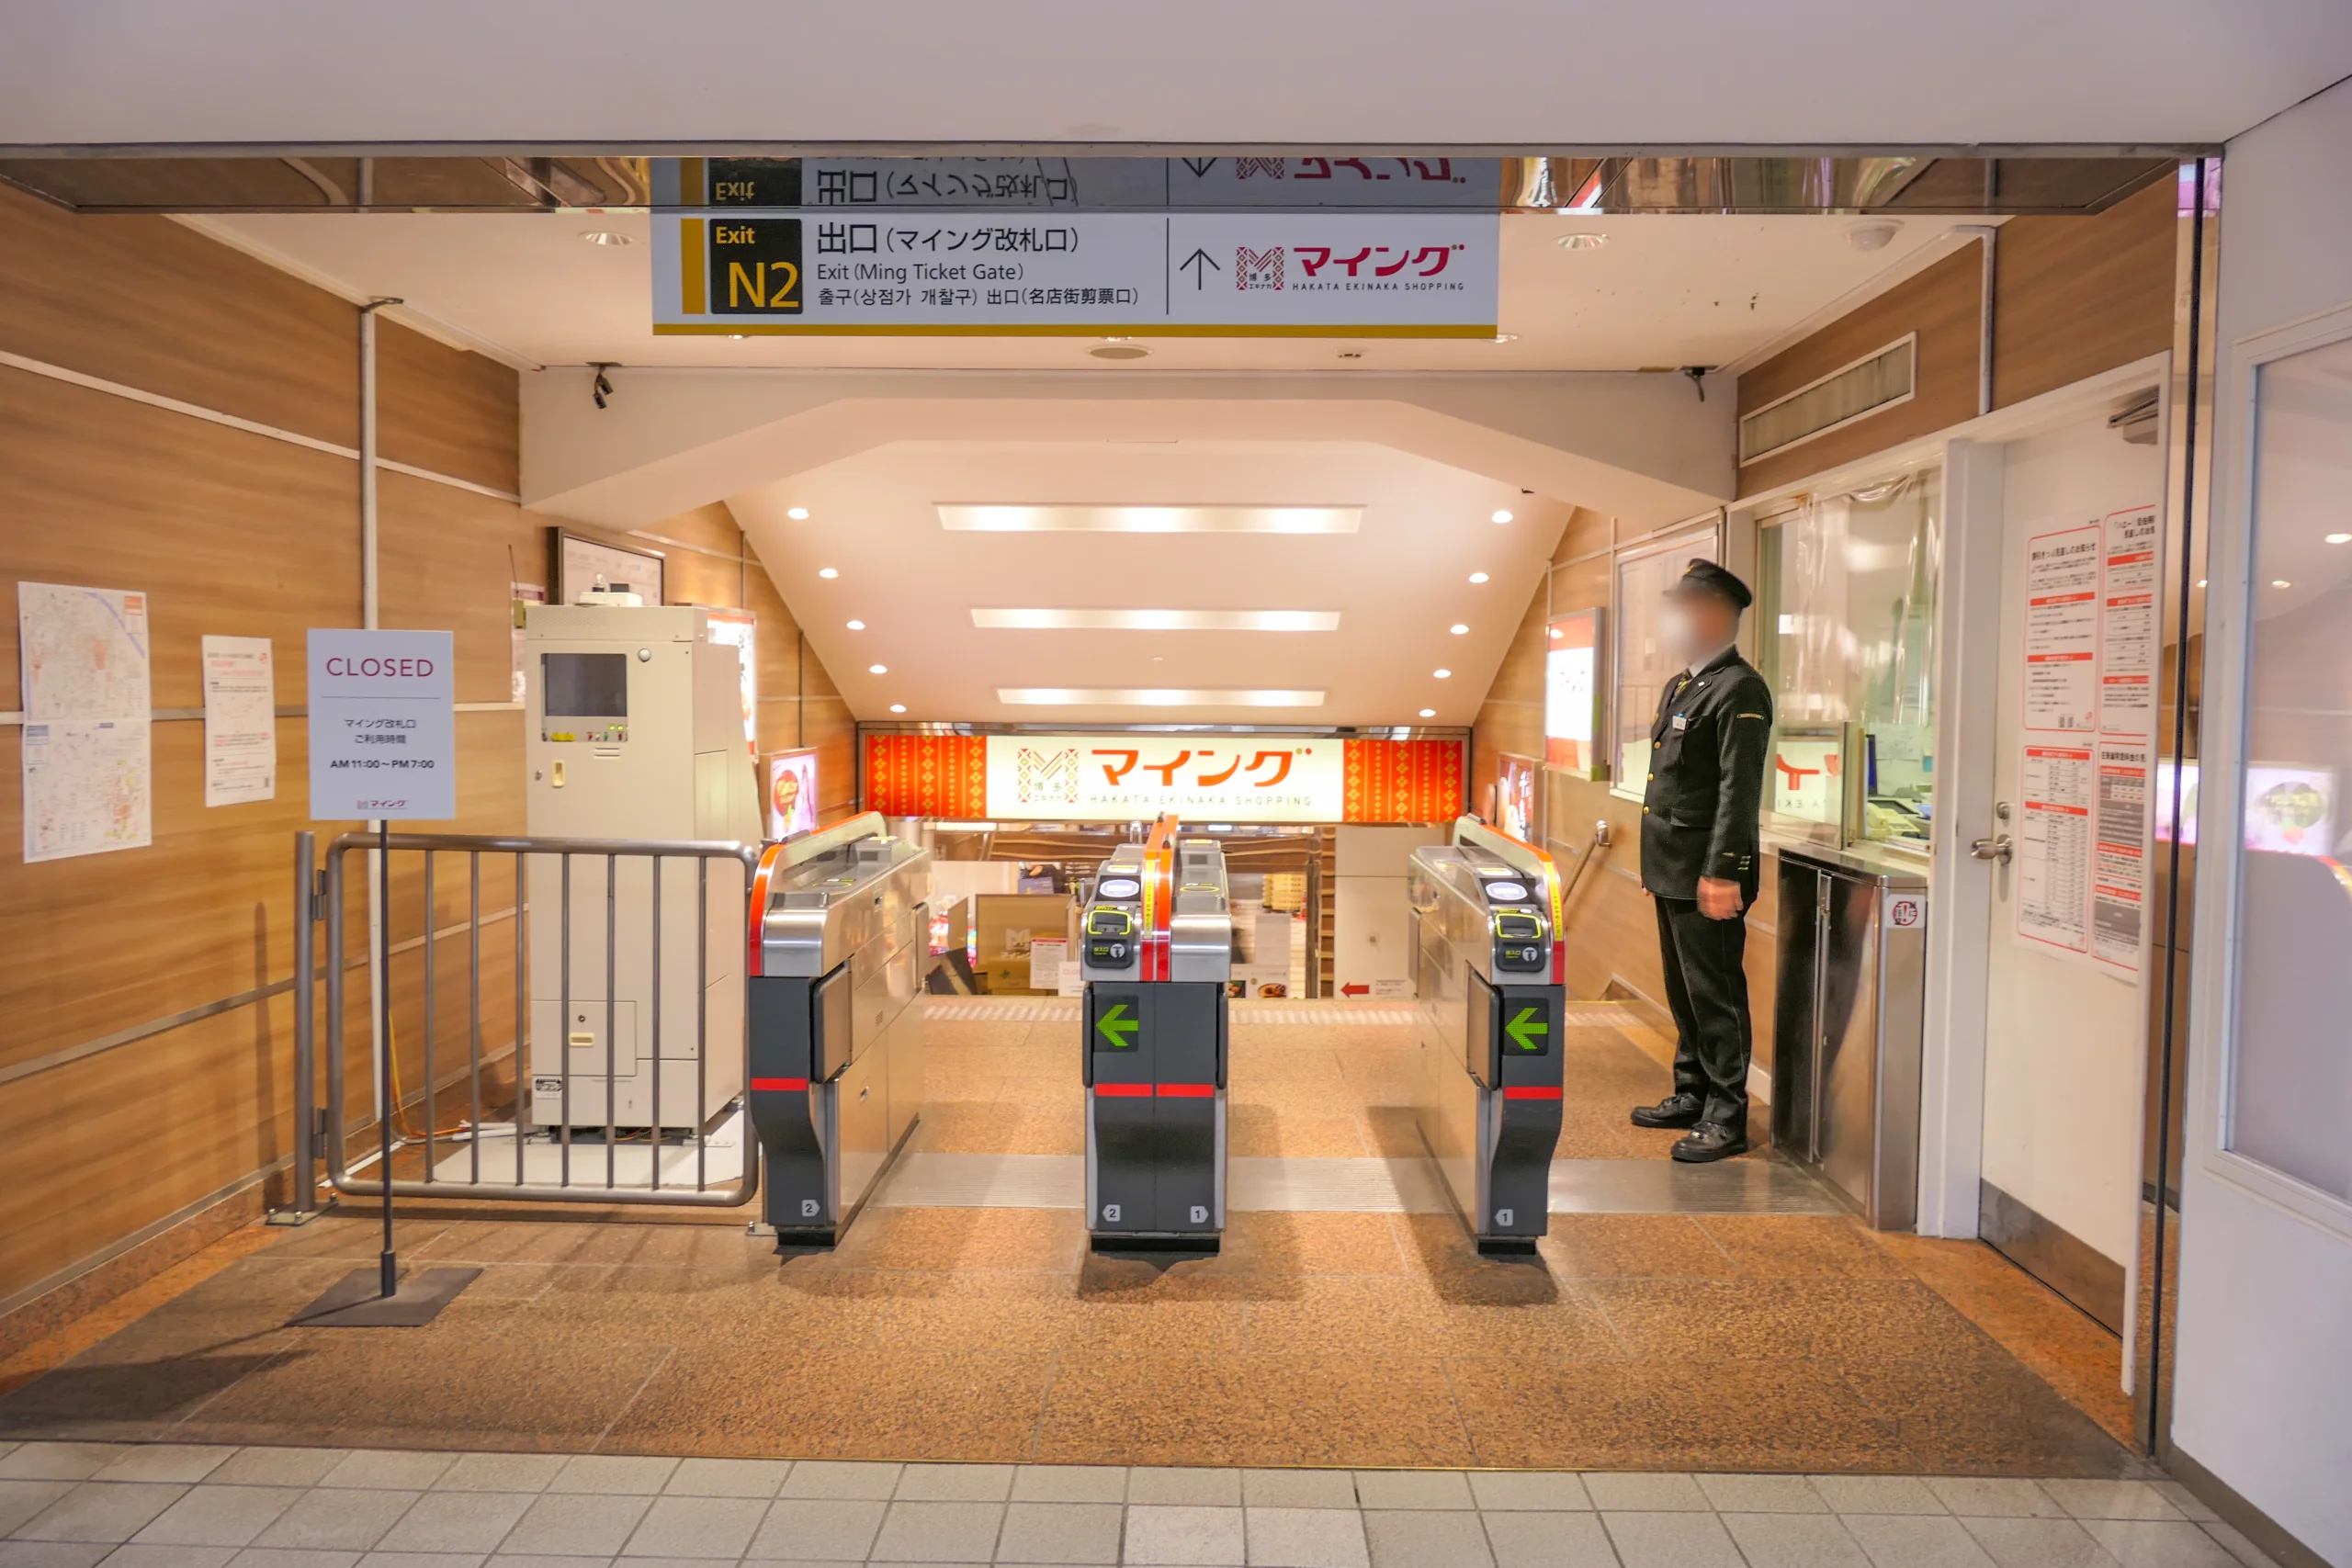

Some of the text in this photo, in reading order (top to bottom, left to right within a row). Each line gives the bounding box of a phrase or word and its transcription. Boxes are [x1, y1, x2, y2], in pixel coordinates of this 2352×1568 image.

[716, 226, 756, 244] Exit
[1294, 244, 1464, 276] マイング
[818, 263, 850, 280] Exit
[912, 263, 967, 280] Ticket
[729, 261, 799, 308] N2
[1292, 282, 1464, 291] HAKATA EKINAKA SHOPPING
[326, 657, 434, 677] CLOSED
[345, 718, 416, 729] マイング改札口
[1091, 748, 1312, 787] マイング
[1091, 795, 1149, 804] HAKATA
[1236, 795, 1311, 806] SHOPPING
[1108, 1209, 1116, 1219] 2
